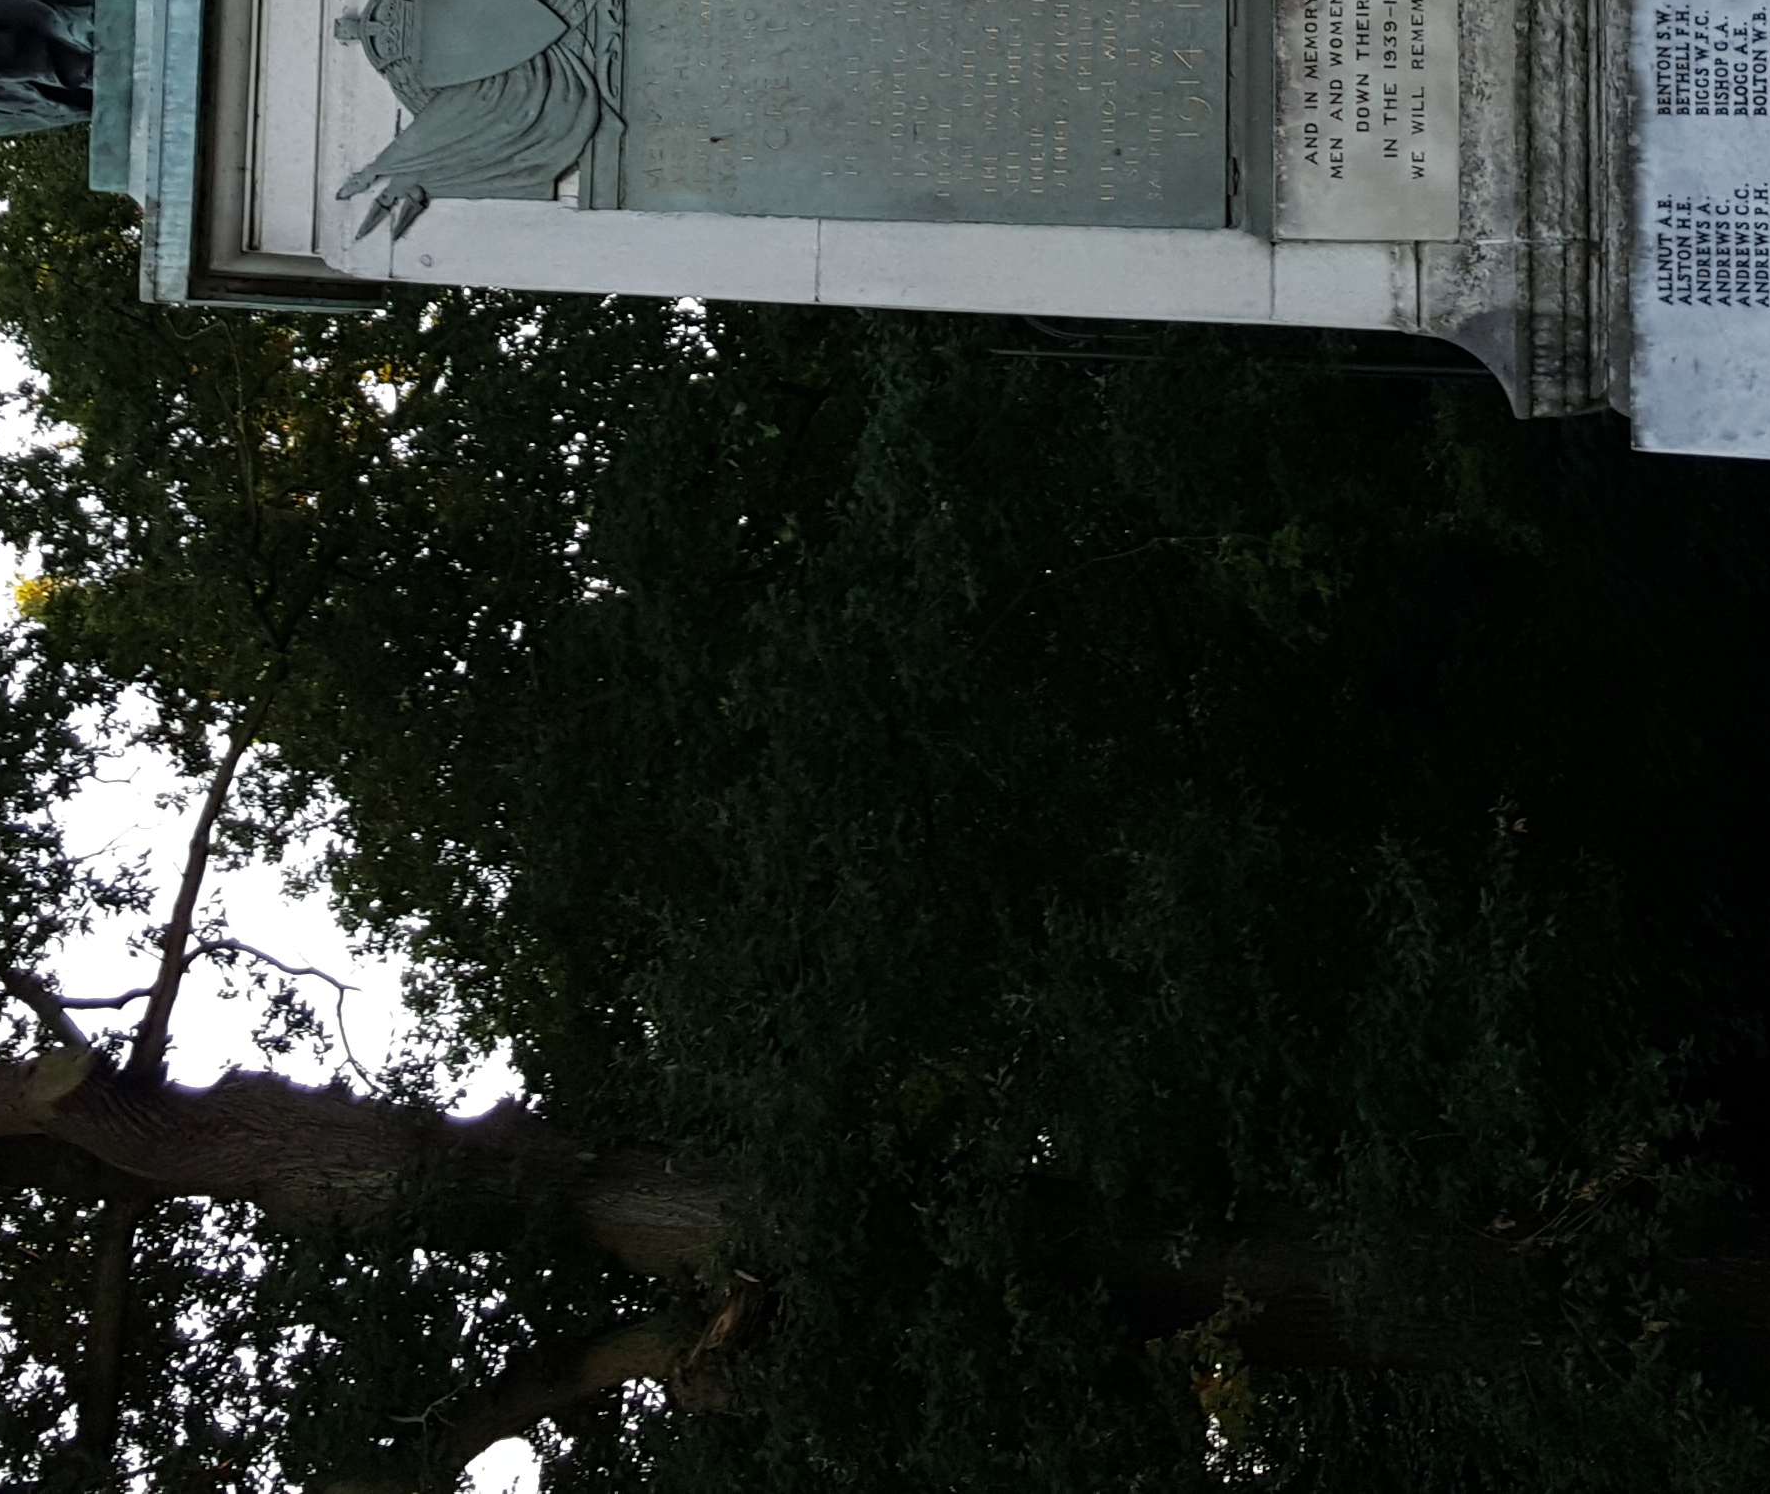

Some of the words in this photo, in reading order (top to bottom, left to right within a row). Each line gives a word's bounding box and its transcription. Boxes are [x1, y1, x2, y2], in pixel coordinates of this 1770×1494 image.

[1356, 0, 1370, 60] THEIR
[1656, 5, 1671, 40] S.W.
[1675, 4, 1690, 36] F.H.
[1733, 22, 1748, 55] A.E.
[1752, 7, 1767, 43] W.B.
[1656, 46, 1672, 115] BENTON
[1676, 42, 1690, 115] BETHELL
[1715, 58, 1729, 116] BISHOP
[1752, 50, 1767, 116] BOLTON
[1304, 92, 1318, 109] IN
[1329, 80, 1343, 122] AND
[1356, 74, 1370, 132] DOWN
[1383, 83, 1397, 126] THE
[1411, 86, 1424, 135] WILL
[1304, 123, 1318, 165] AND
[1330, 138, 1343, 179] MEN
[1383, 139, 1398, 158] IN
[1412, 152, 1425, 179] WE
[1657, 194, 1672, 228] A.E.
[1676, 197, 1691, 229] H.E.
[1696, 196, 1710, 215] A.
[1715, 199, 1730, 215] C.
[1754, 183, 1768, 215] P.H.
[1657, 233, 1673, 305] ALLNUT
[1677, 236, 1692, 306] ALSTON
[1696, 221, 1711, 306] ANDREWS
[1716, 222, 1731, 307] ANDREWS
[1735, 222, 1751, 307] ANDREWS
[1754, 222, 1769, 308] ANDREWS
